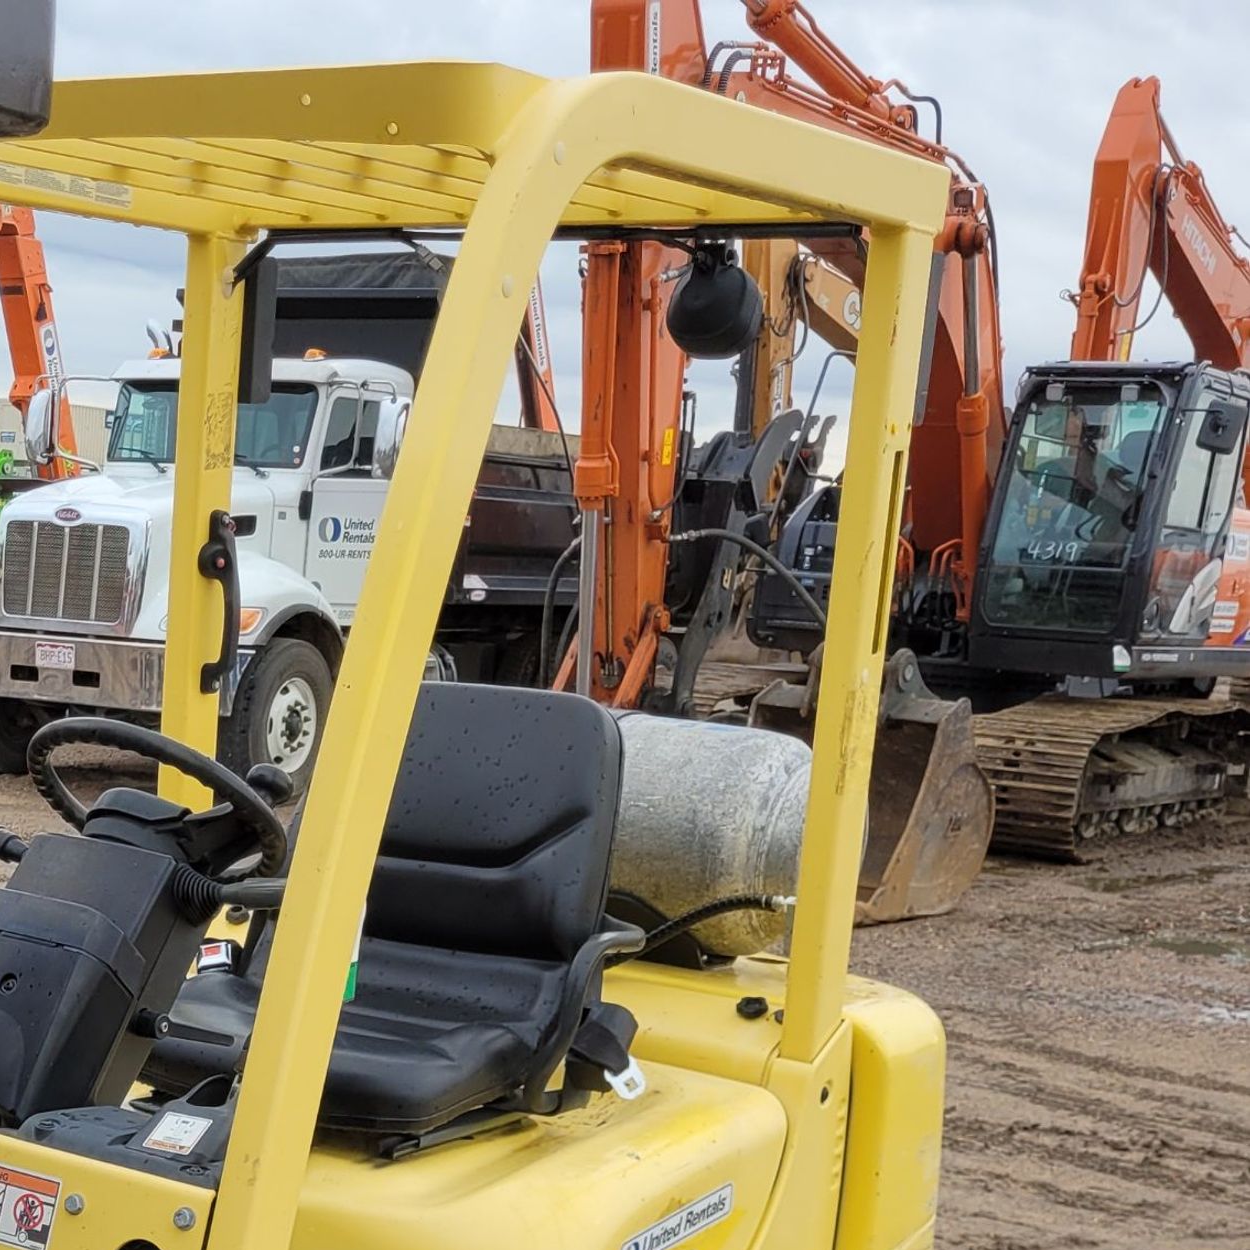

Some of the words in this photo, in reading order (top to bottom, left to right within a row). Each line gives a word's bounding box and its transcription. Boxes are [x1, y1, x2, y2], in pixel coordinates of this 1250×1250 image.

[1181, 213, 1217, 276] HITACHI
[530, 286, 540, 321] nited
[342, 532, 376, 544] Rentals
[343, 518, 375, 531] United
[1027, 540, 1079, 562] 4319
[683, 1193, 728, 1231] Rentals
